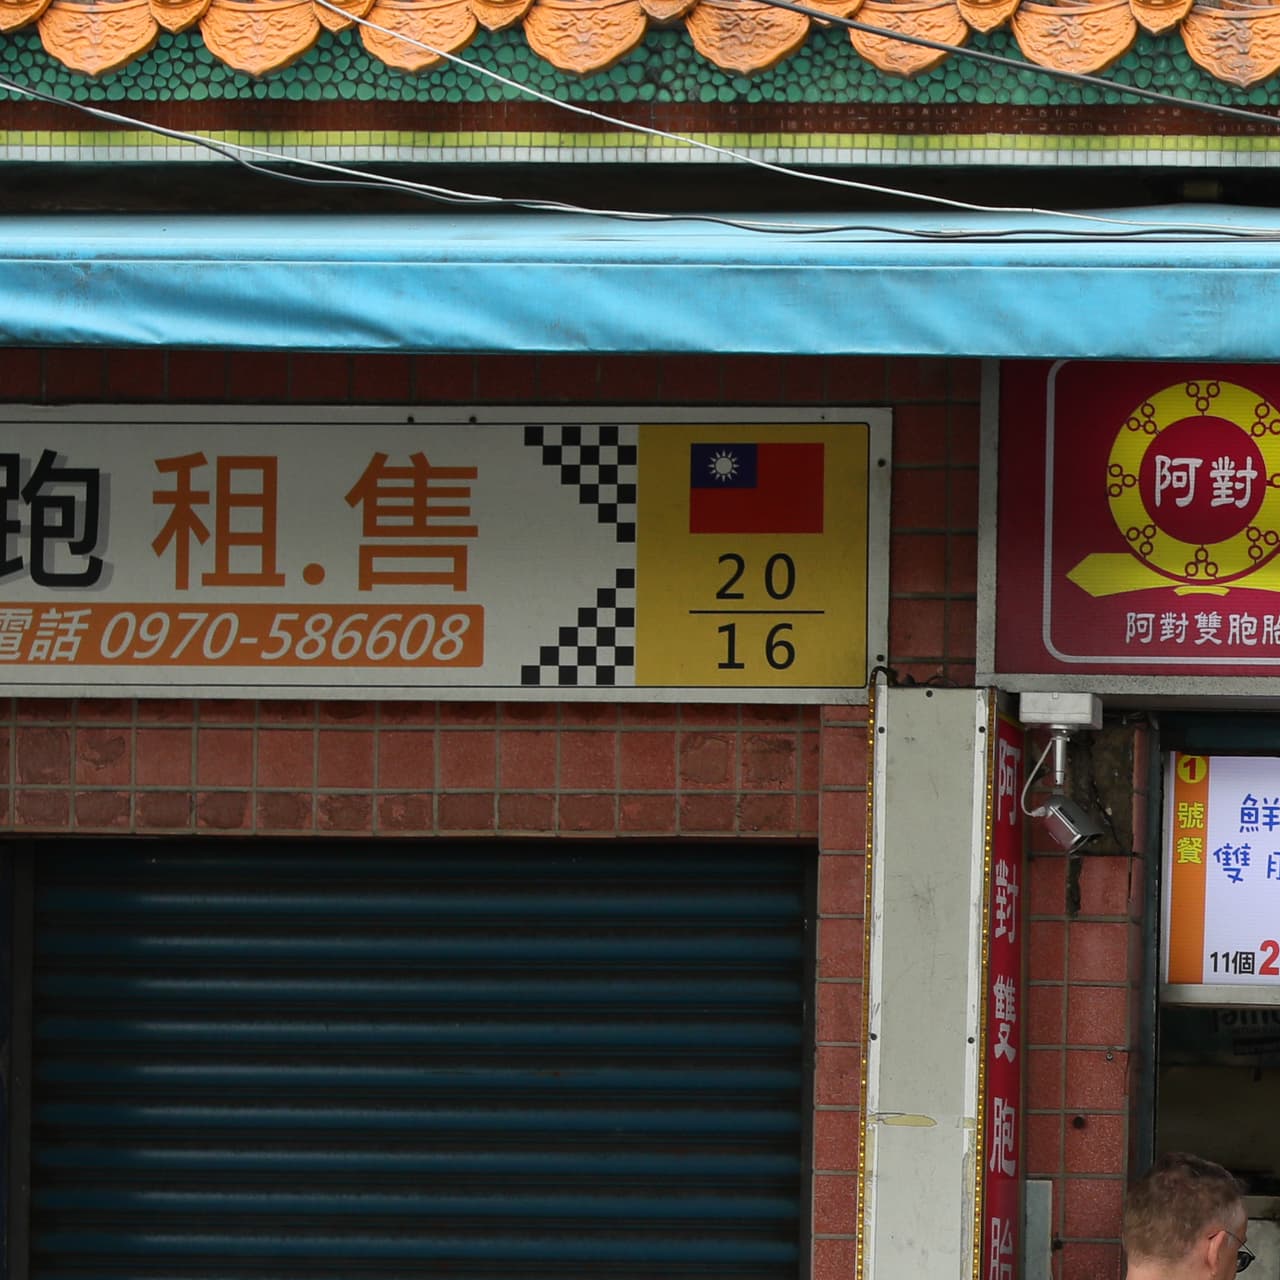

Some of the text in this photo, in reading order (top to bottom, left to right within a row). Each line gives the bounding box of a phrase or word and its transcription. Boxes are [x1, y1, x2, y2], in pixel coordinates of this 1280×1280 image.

[1153, 455, 1259, 509] 阿對
[715, 552, 798, 601] 20
[100, 612, 471, 661] 0970-586608
[717, 622, 798, 671] 16
